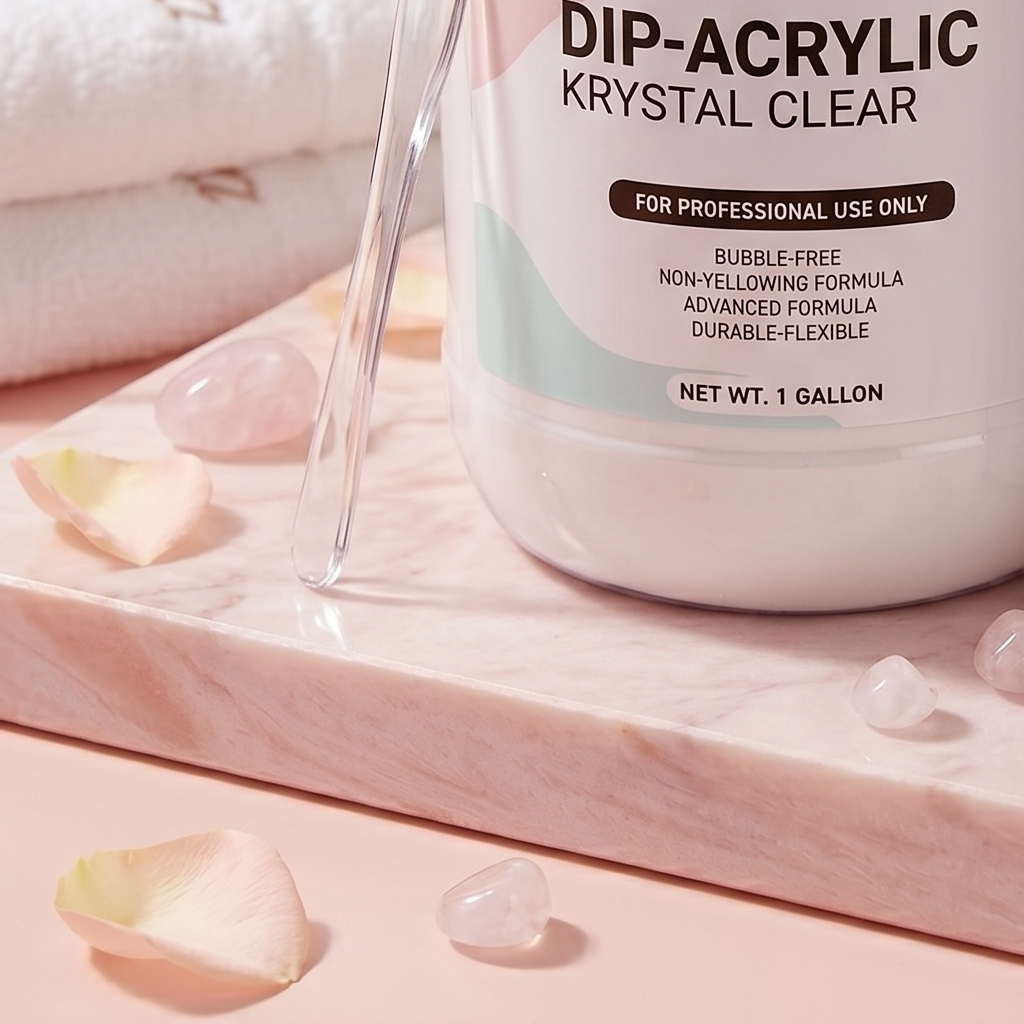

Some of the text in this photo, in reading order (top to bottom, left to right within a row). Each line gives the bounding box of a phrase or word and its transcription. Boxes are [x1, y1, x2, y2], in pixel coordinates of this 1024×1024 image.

[561, 0, 979, 77] DIP-ACRYLIC
[562, 69, 918, 128] KRYSTAL CLEAR
[635, 192, 928, 220] FOR PROFESSIONAL USE ONLY
[714, 248, 841, 267] BUBBLE-FREE
[659, 268, 904, 292] NON-YELLOWING FORMULA
[683, 296, 877, 316] ADVANCED FORMULA
[691, 320, 870, 341] DURABLE-FLEXIBLE
[680, 382, 883, 406] NET WT. 1 GALLON
